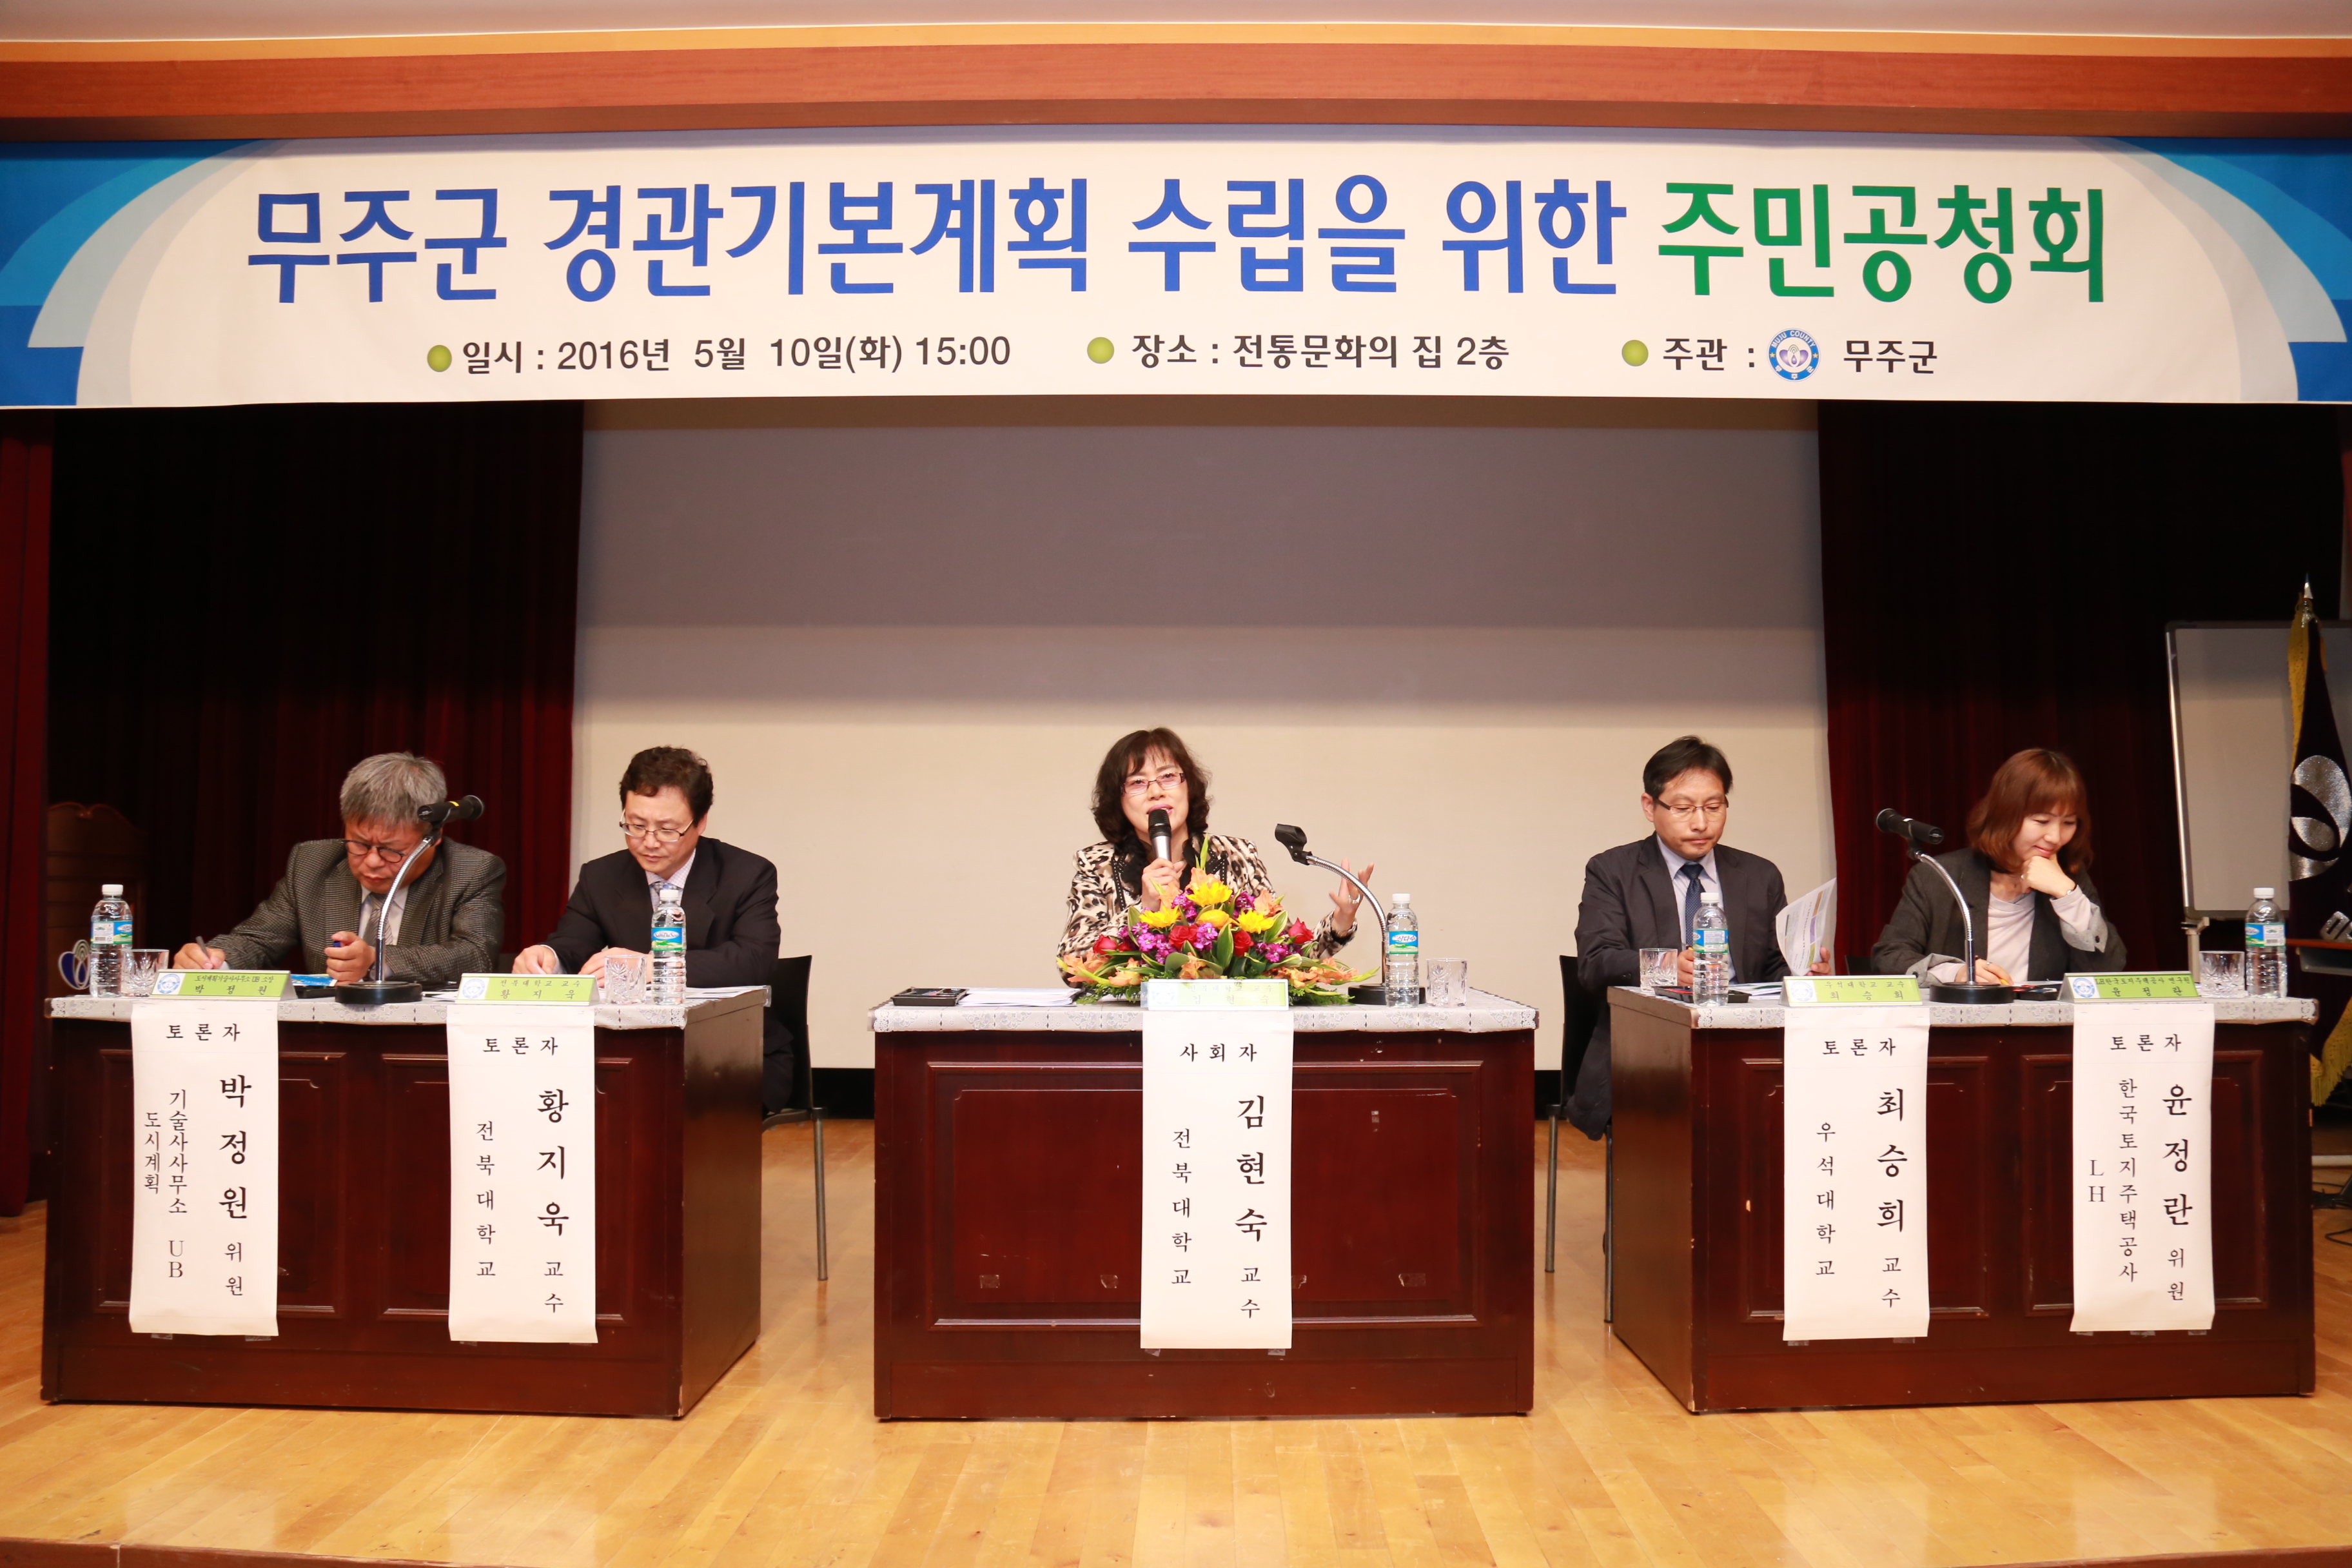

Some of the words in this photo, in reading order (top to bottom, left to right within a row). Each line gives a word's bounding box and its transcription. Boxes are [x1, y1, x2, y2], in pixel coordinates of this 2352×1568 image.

[247, 188, 508, 304] 무주군
[543, 177, 1088, 303] 경관기본계획
[1128, 173, 1406, 293] 수립을
[1442, 178, 1627, 295] 위한
[1658, 181, 2104, 305] 주민공청회
[462, 340, 522, 375] 일시
[556, 338, 670, 372] 2016년
[694, 337, 745, 371] 5월
[770, 335, 903, 375] 10일(화)
[915, 335, 1011, 366] 15:00
[1131, 333, 1198, 369] 장소
[1232, 333, 1398, 369] 전통문화의
[1411, 335, 1442, 369] 집
[1456, 335, 1510, 371] 2층
[1662, 337, 1729, 371] 주관
[1843, 339, 1938, 375] 무주군
[1771, 332, 1787, 348] MUJU
[1790, 330, 1816, 347] COUNTY
[165, 1022, 241, 1043] 토론자
[482, 1036, 559, 1056] 토론자
[1179, 1042, 1258, 1063] 사회자
[1821, 1037, 1897, 1057] 토론자
[2110, 1033, 2182, 1052] 토론자
[143, 1112, 162, 1195] 도시계획
[168, 1088, 189, 1214] 기술사사무소
[218, 1073, 253, 1220] 박정원
[536, 1088, 570, 1237] 황지욱
[1234, 1094, 1268, 1243] 김현숙
[1876, 1087, 1908, 1233] 최승희
[2161, 1083, 2194, 1226] 윤정란
[476, 1120, 496, 1277] 전북대학교
[1171, 1127, 1193, 1285] 전북대학교
[1815, 1121, 1837, 1276] 우석대학교
[2118, 1077, 2139, 1283] 한국토지주택공사
[224, 1241, 243, 1297] 위원
[544, 1261, 564, 1314] 교수
[1240, 1266, 1262, 1319] 교수
[1881, 1257, 1902, 1309] 교수
[2167, 1248, 2184, 1301] 위원
